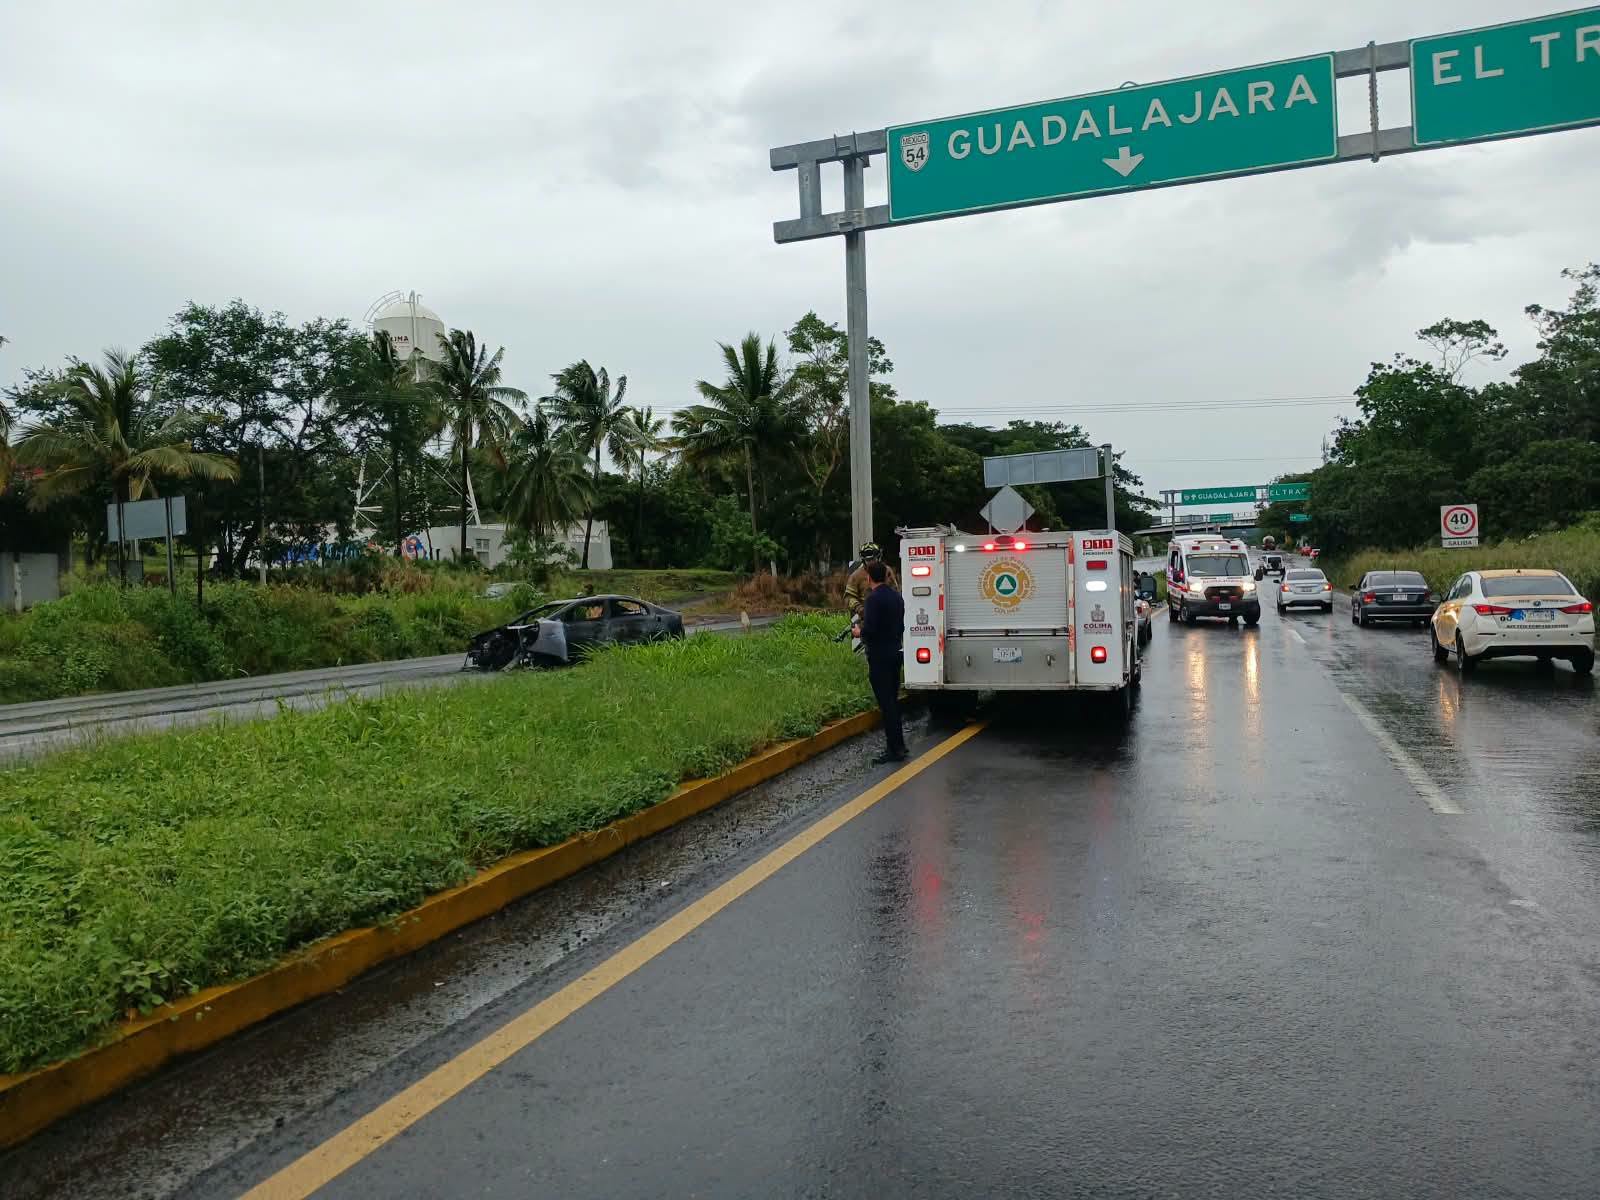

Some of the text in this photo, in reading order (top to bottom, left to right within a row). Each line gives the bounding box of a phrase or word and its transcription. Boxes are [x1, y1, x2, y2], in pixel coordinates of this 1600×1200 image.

[1432, 24, 1600, 86] EL TR
[947, 73, 1319, 160] GUADALAJARA
[906, 147, 925, 163] 54
[1197, 491, 1255, 501] GUADALAJARA
[1450, 513, 1469, 525] 40
[1083, 540, 1112, 549] 911
[909, 547, 935, 555] 911
